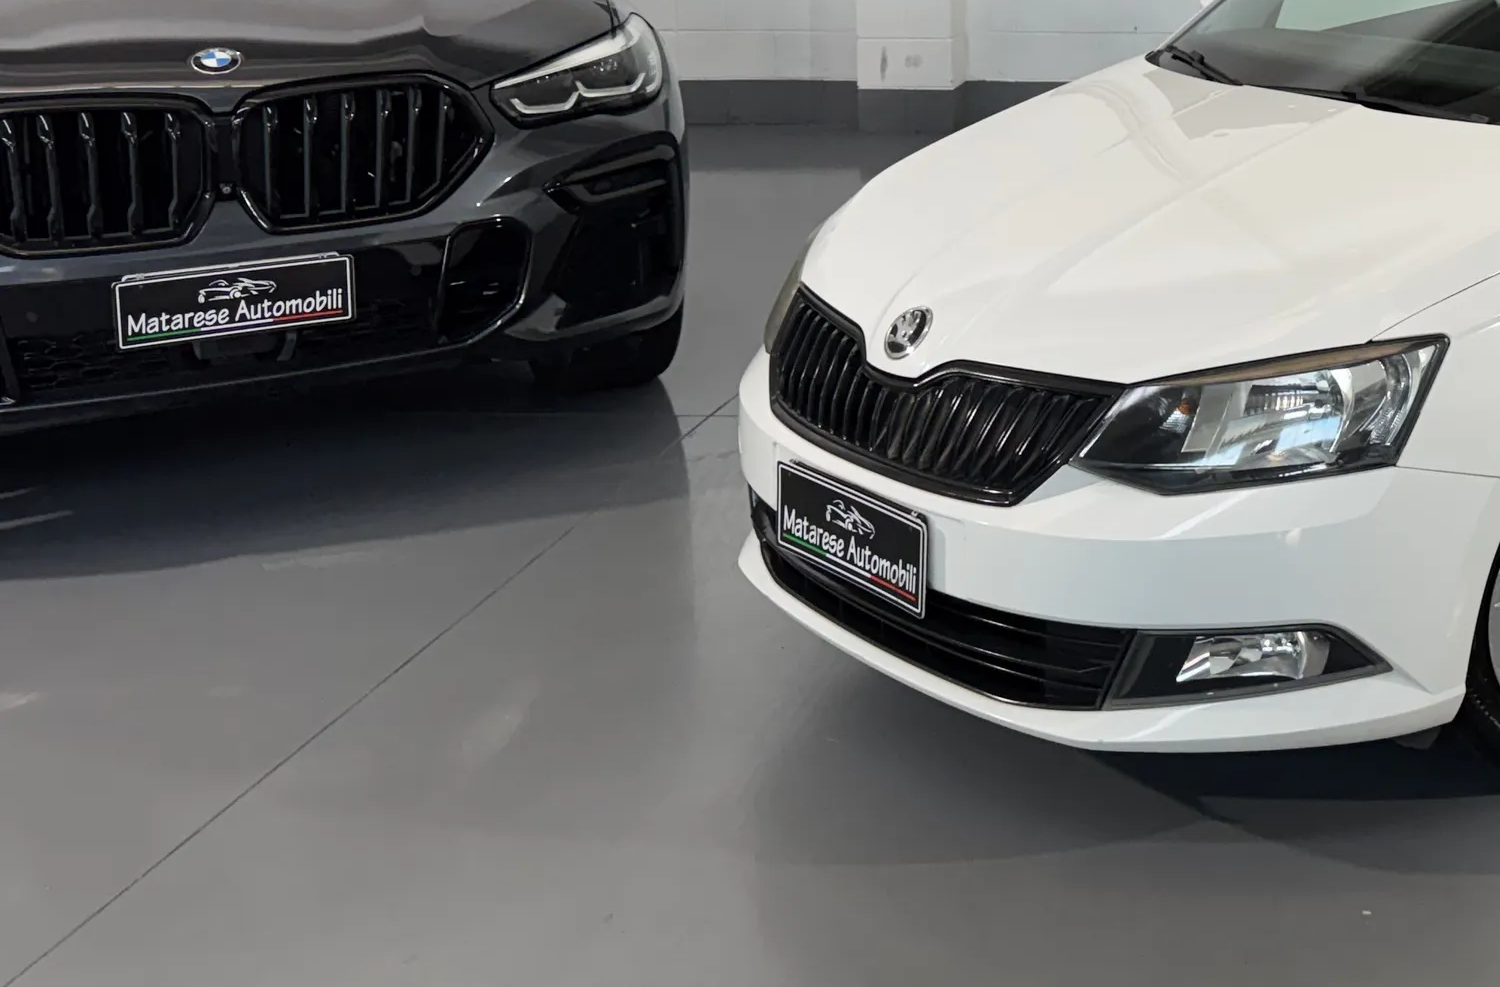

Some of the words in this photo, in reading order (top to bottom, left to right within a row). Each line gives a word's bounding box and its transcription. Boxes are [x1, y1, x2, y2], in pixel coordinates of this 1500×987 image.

[127, 308, 230, 336] Matarese
[234, 288, 343, 322] Automobili
[783, 505, 845, 557] Matarese
[846, 535, 917, 594] Automobili
